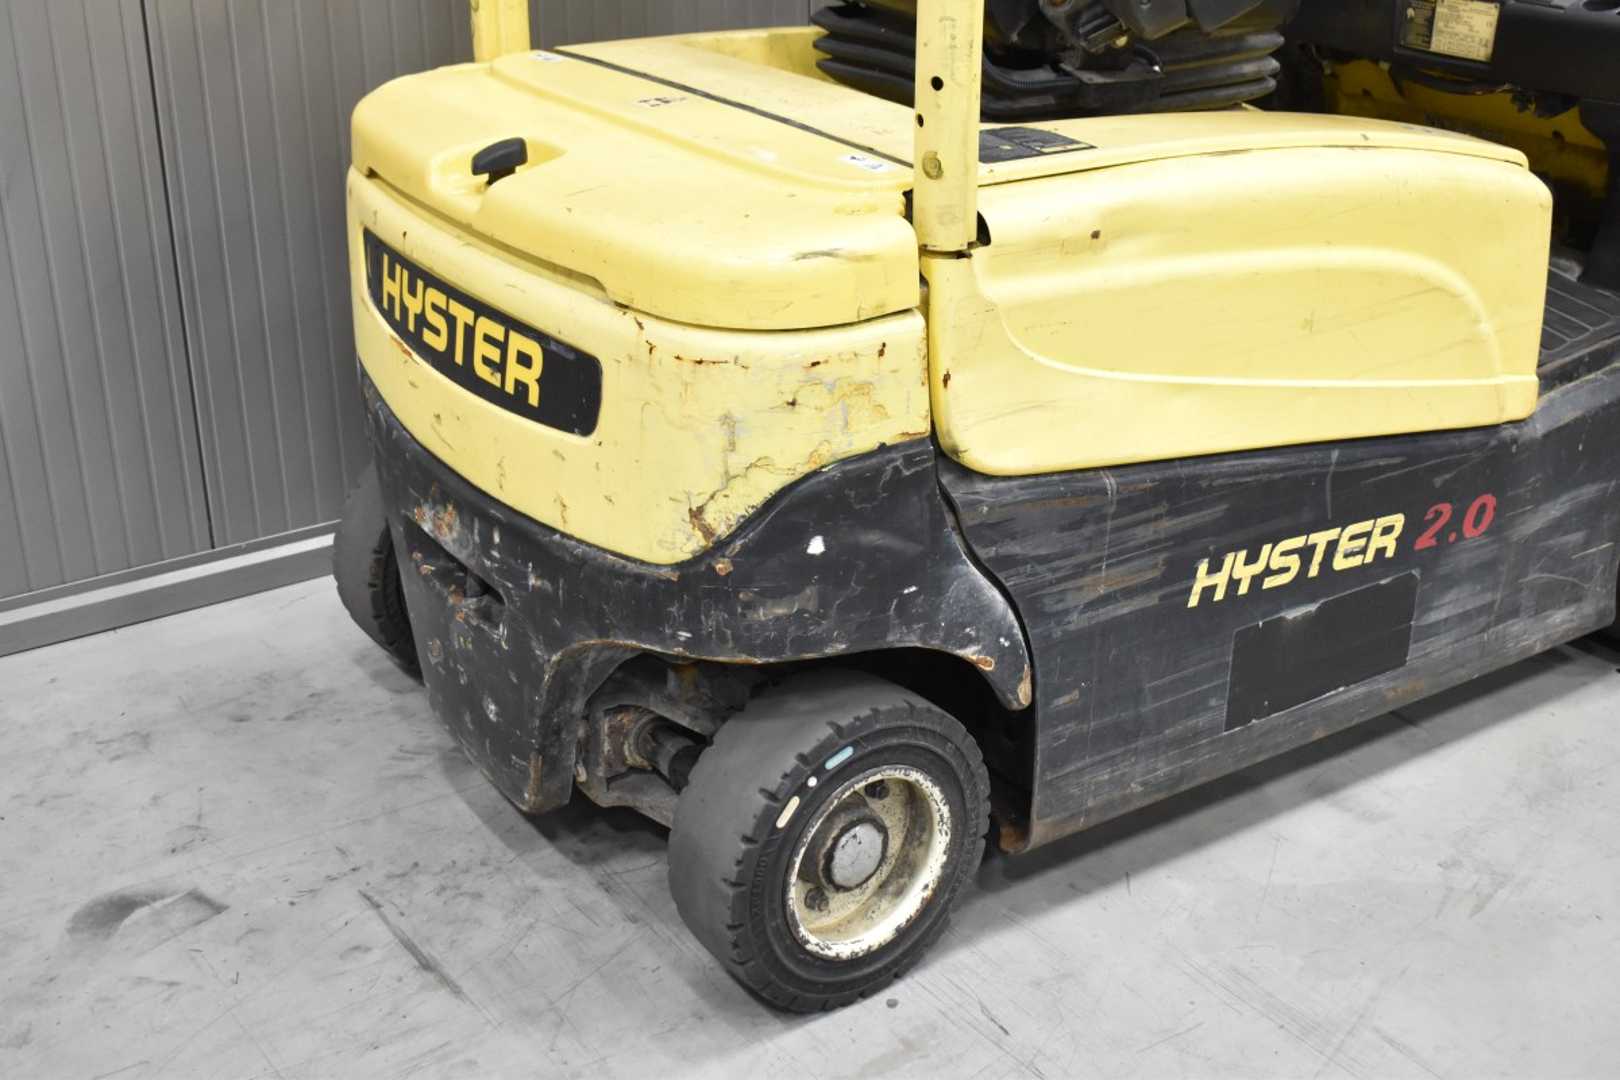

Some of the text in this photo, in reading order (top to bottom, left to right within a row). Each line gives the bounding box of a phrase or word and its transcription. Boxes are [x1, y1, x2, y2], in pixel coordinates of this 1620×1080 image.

[382, 253, 544, 408] HYSTER
[1187, 494, 1497, 608] HYSTER 2.0
